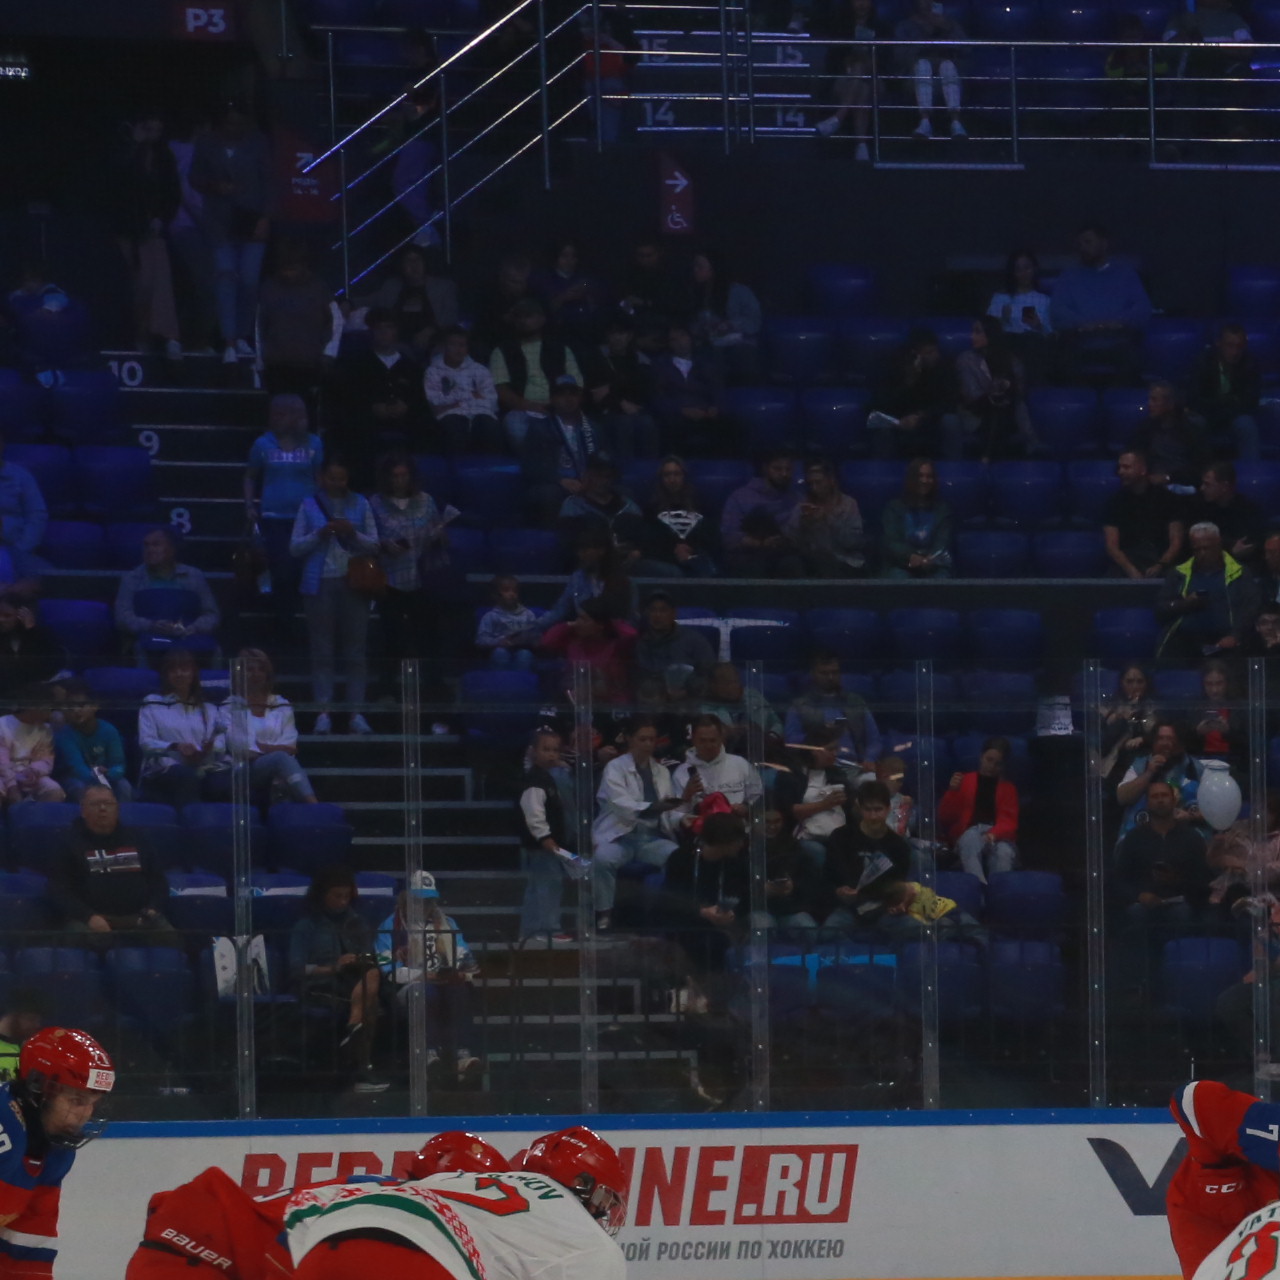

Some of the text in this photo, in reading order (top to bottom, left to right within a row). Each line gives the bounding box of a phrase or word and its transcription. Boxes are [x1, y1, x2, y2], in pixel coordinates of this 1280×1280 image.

[643, 101, 676, 126] 14
[138, 430, 160, 456] 9
[656, 1241, 731, 1260] РОССИИ
[737, 1240, 762, 1259] ПО
[767, 1239, 845, 1259] ХОККЕЮ
